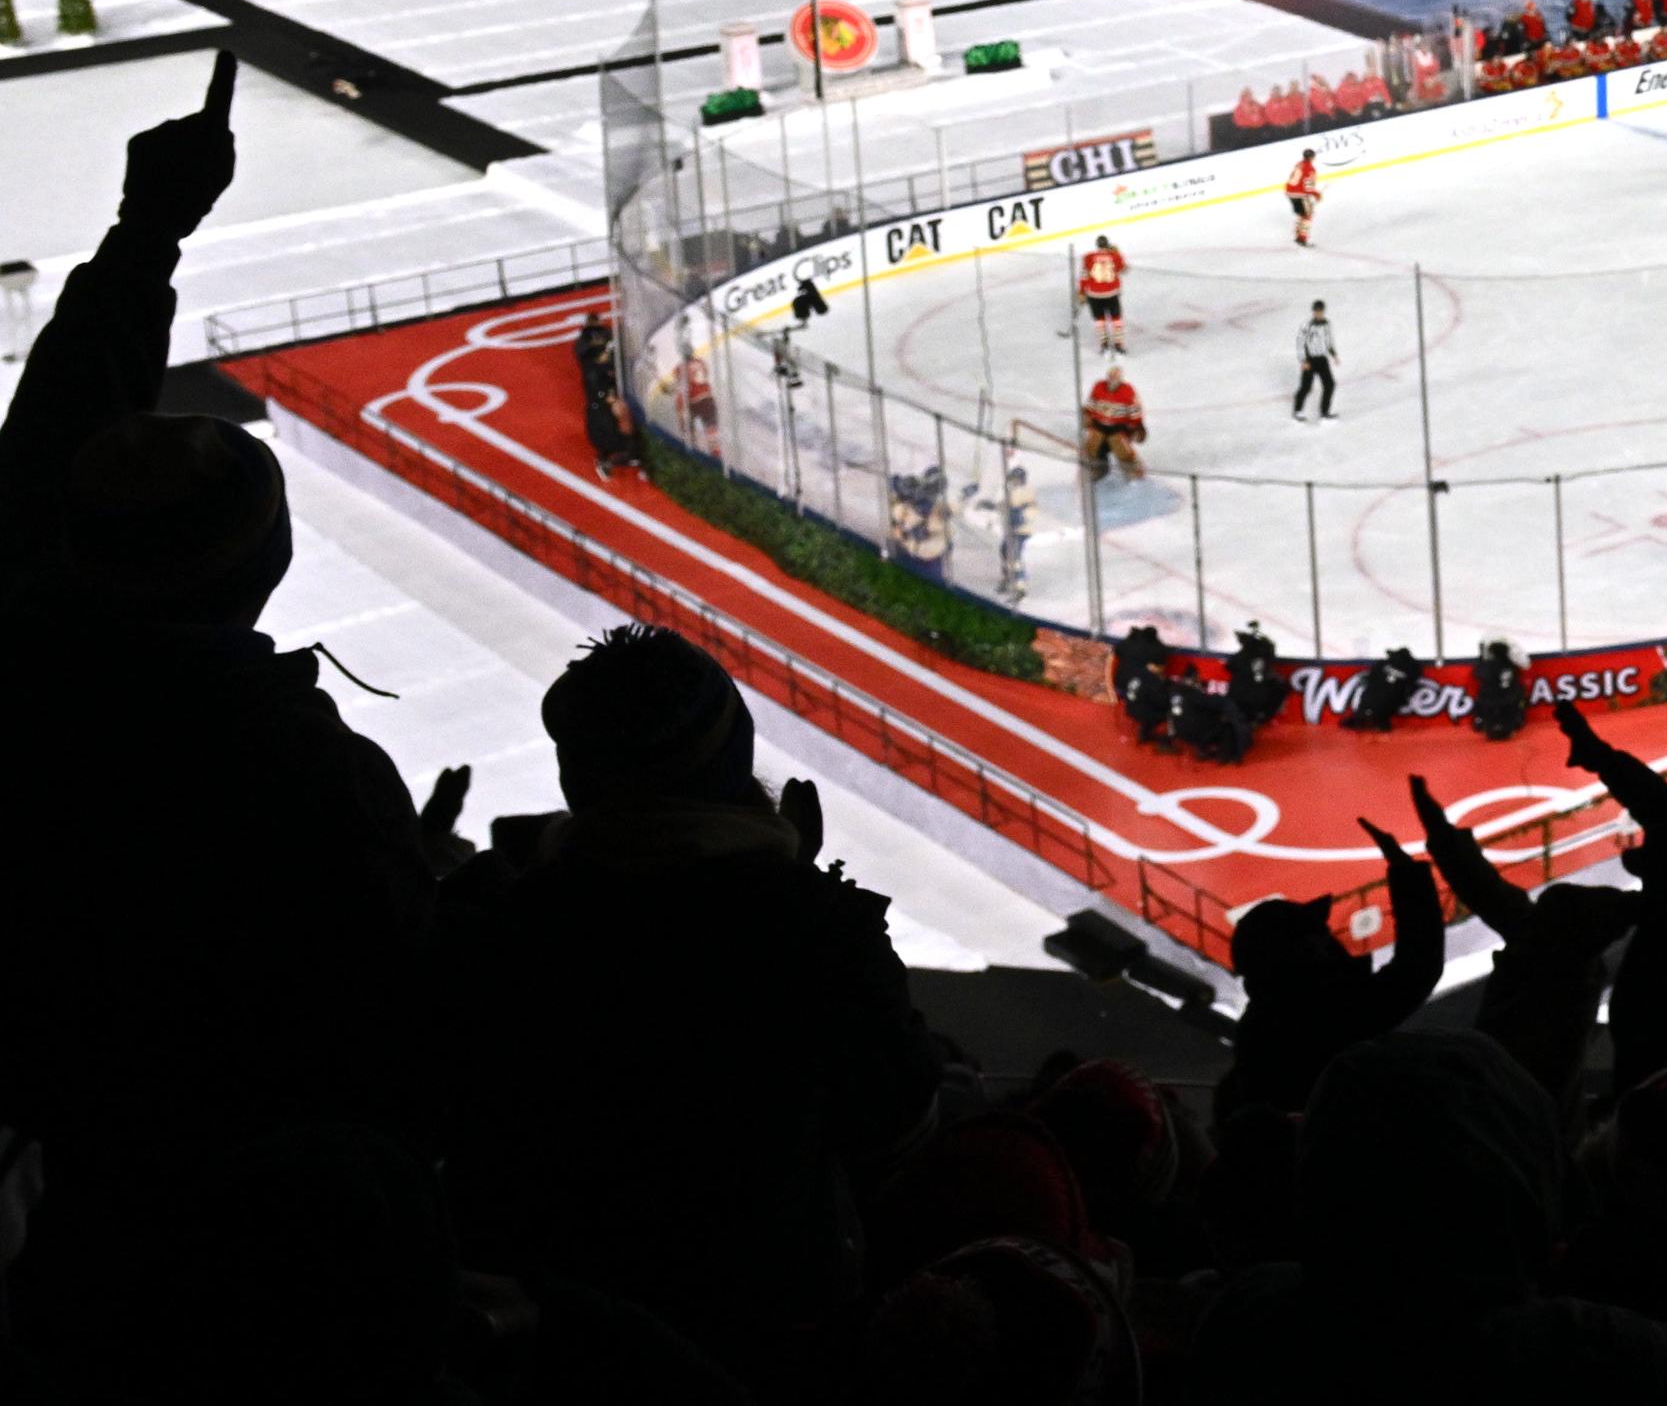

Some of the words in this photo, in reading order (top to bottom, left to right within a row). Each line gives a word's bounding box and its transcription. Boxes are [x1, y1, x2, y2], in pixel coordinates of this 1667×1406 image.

[1048, 137, 1139, 186] CHI
[886, 218, 943, 264] CAT
[987, 196, 1045, 240] CAT
[724, 271, 788, 315] Great
[792, 247, 853, 285] Clips
[1531, 667, 1639, 705] ASSIC
